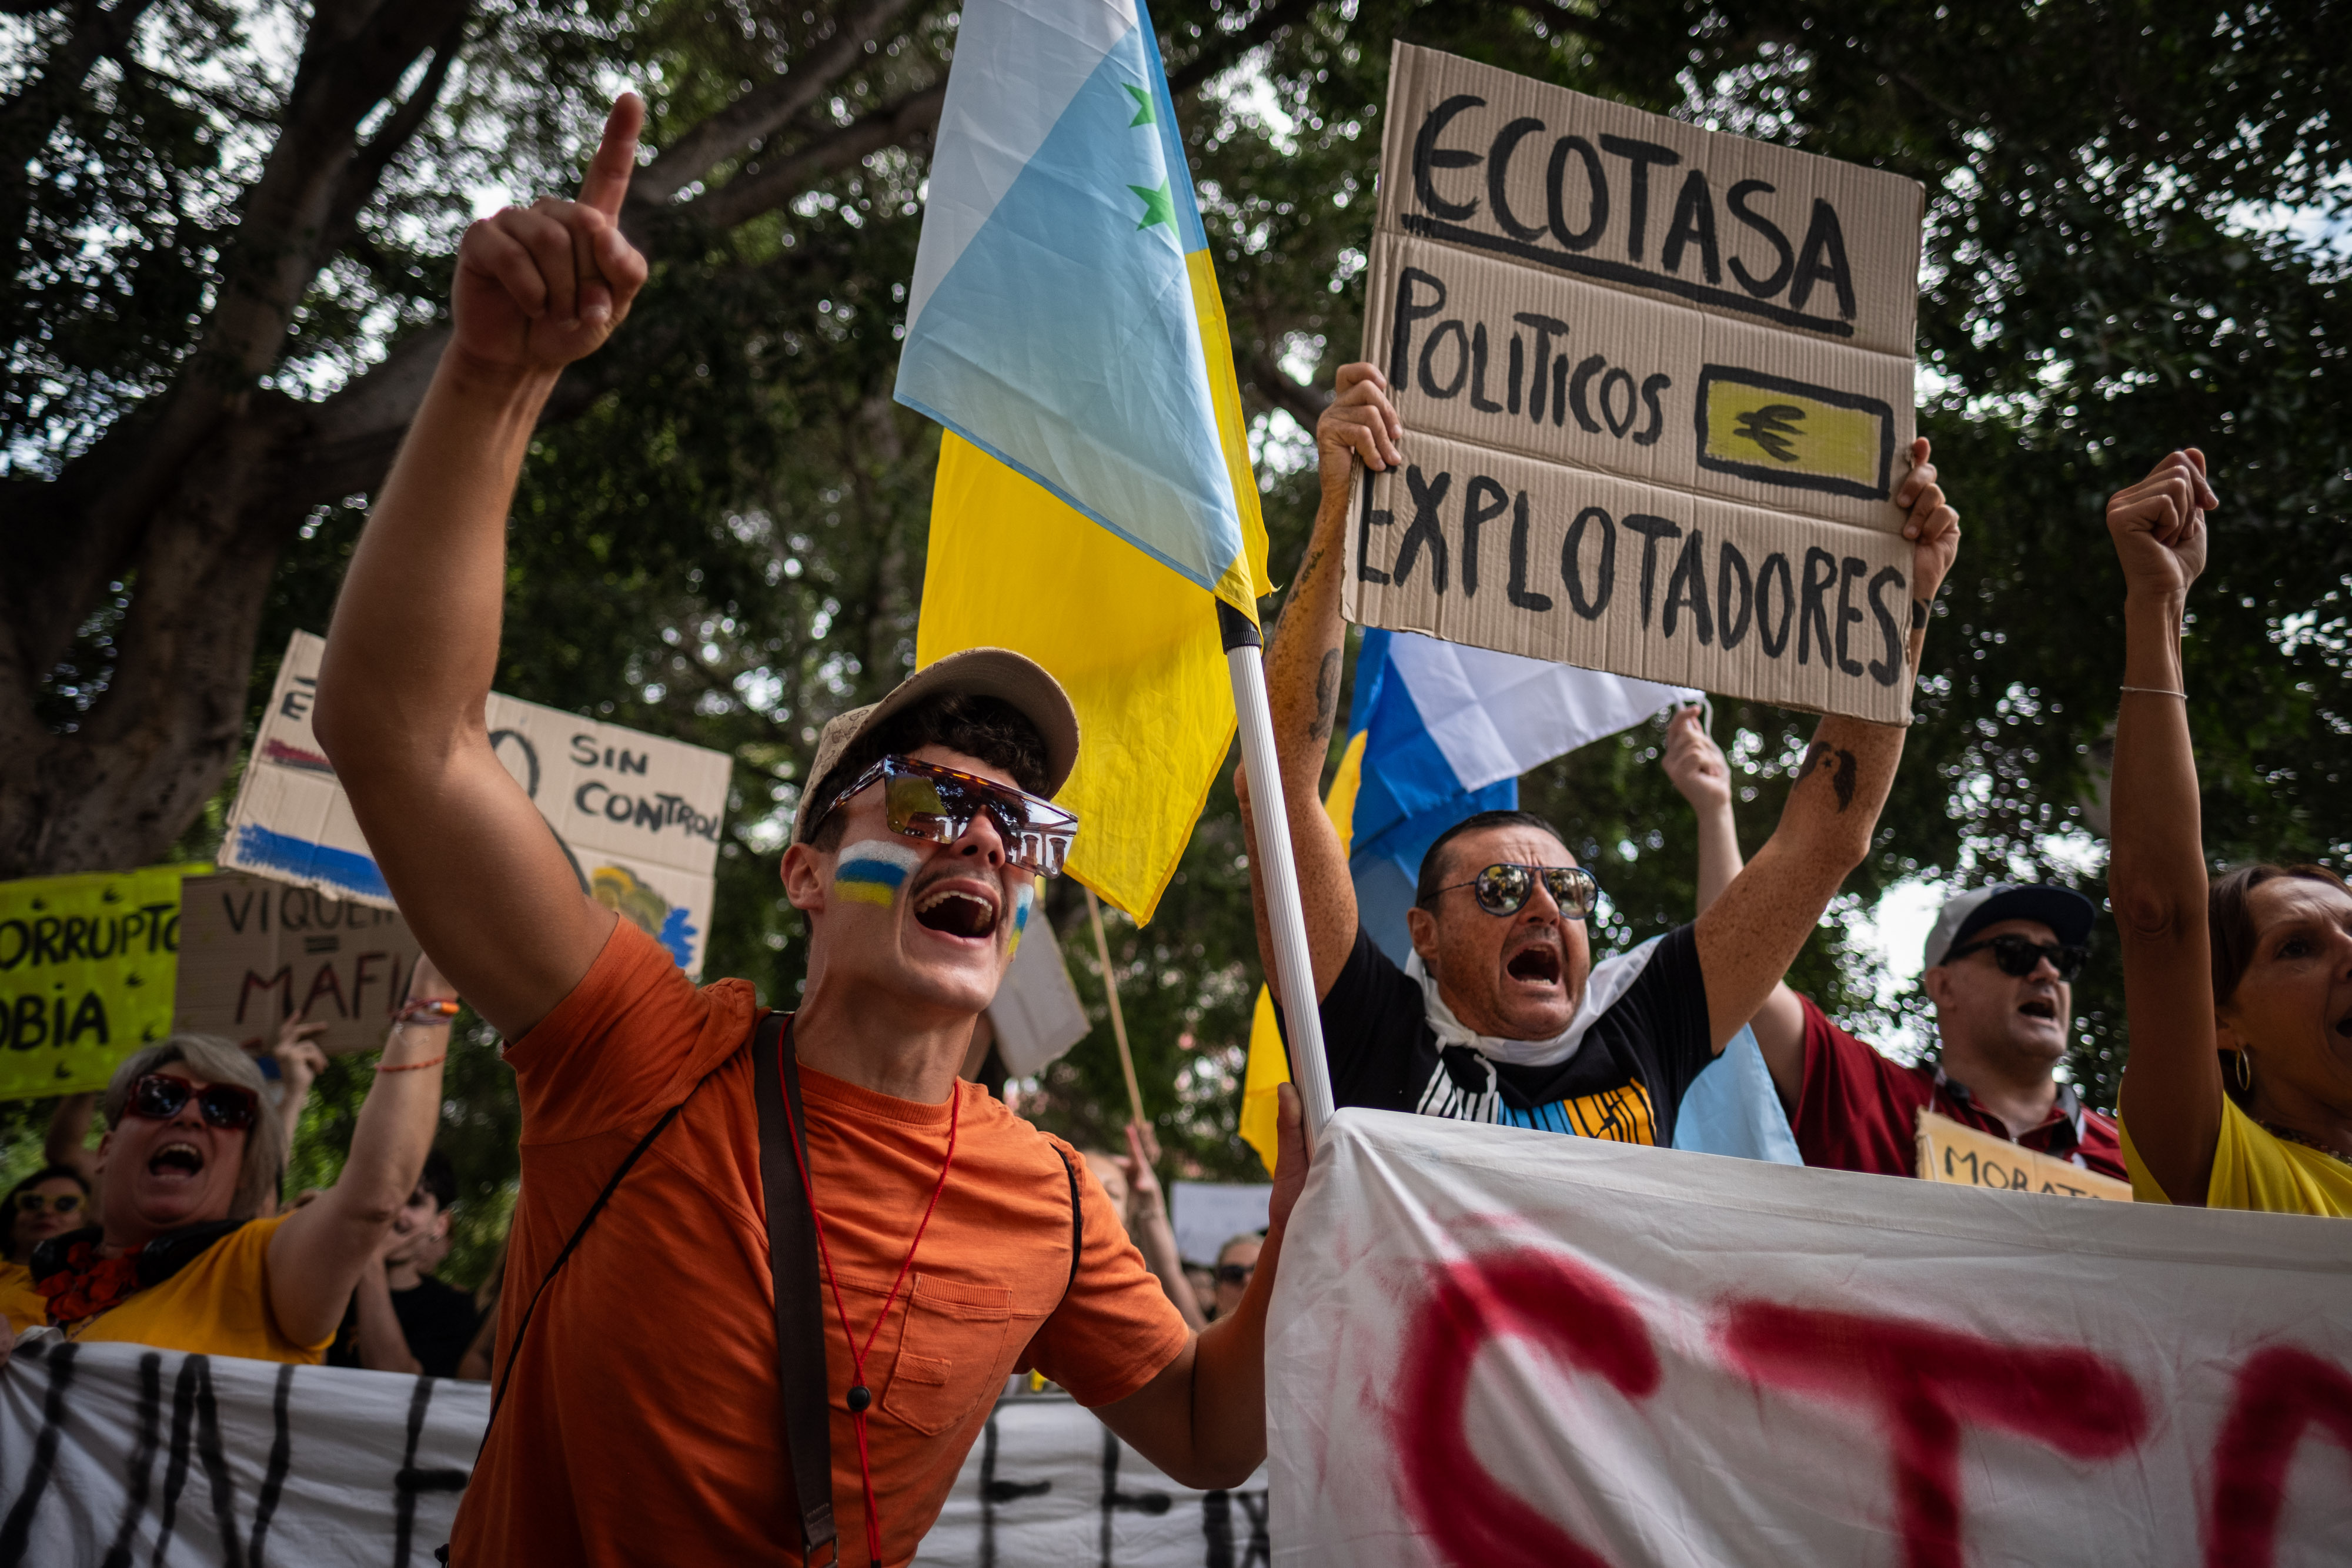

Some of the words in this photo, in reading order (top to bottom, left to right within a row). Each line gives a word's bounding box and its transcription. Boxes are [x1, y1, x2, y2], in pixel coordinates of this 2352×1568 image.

[1412, 94, 1857, 318] ECOTASA
[1390, 267, 1672, 446] POLITICOS
[1357, 464, 1906, 687] EXPLOTADORES
[570, 733, 649, 776] SIN
[574, 780, 719, 842] CONTROL
[223, 886, 393, 934] VIQUE
[1945, 1145, 2102, 1198] MORAT
